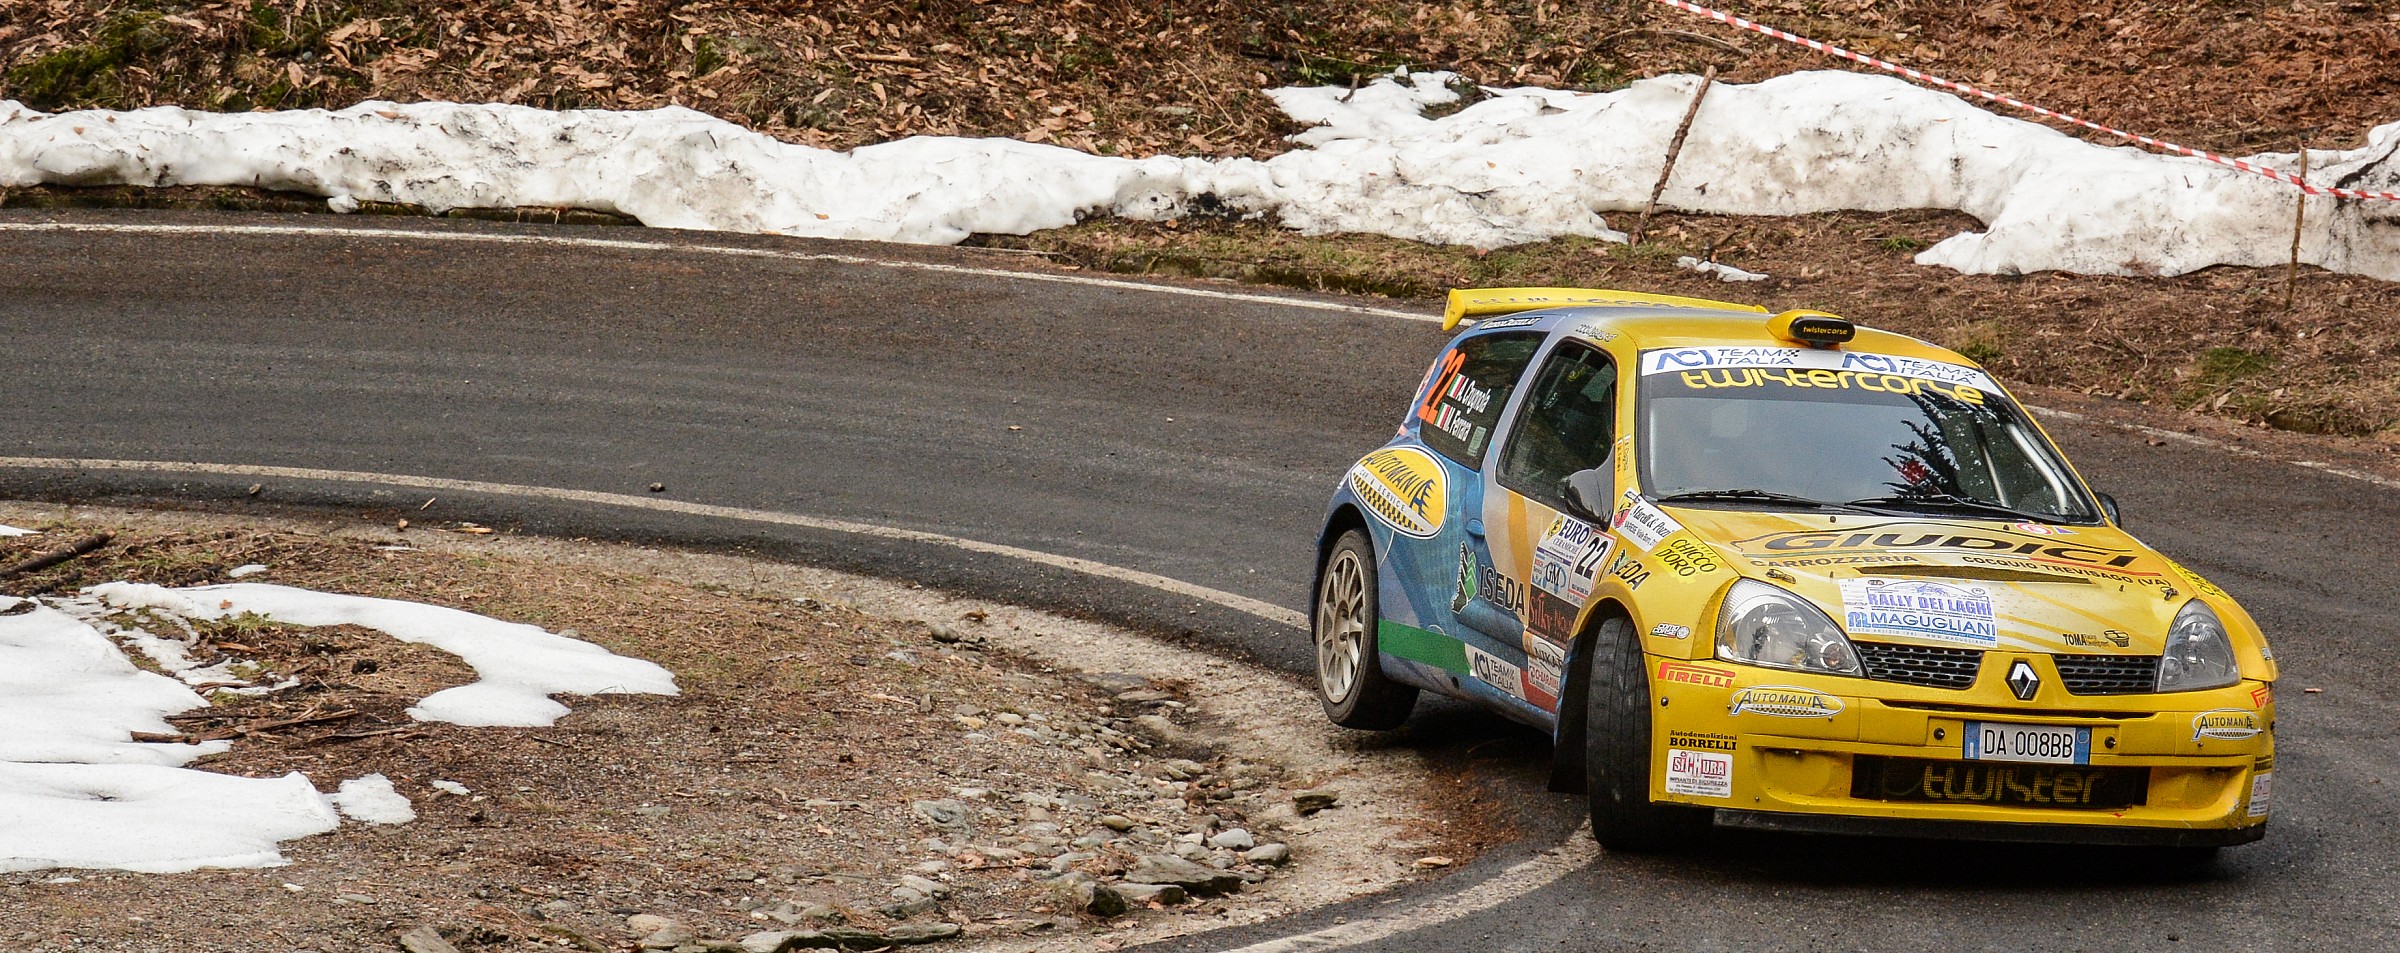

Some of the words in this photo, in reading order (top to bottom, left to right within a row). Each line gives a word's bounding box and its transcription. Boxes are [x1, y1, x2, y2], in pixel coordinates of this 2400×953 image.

[1803, 326, 1848, 335] twistercorse
[1656, 350, 1714, 370] ACI
[1718, 349, 1784, 358] TEAM
[1718, 357, 1794, 366] ITALIA
[1842, 353, 1897, 372] ACI
[1900, 359, 1960, 374] TEAM
[1418, 348, 1466, 425] 22
[1682, 368, 1985, 406] twistercorse
[1900, 367, 1974, 385] ITALIA
[1377, 485, 1406, 512] SERVICE
[1558, 518, 1590, 545] EURO
[1575, 536, 1609, 580] 22
[1670, 539, 1718, 572] CHICCO
[1751, 555, 1919, 568] CARROZZERIA
[1764, 533, 2138, 567] GIUDICI
[1962, 556, 2038, 569] COCQUIO
[2039, 564, 2134, 583] TREVISAGO
[2138, 578, 2172, 587] (VA)
[1479, 564, 1526, 616] ISEDA
[1868, 593, 1913, 608] RALLY
[1918, 596, 1945, 611] DEI
[1947, 599, 1993, 616] LAGHI
[1871, 612, 1996, 636] MAGUGLIANI
[2063, 633, 2087, 646] TOMA
[1658, 662, 1736, 688] PIRELLI
[1733, 690, 1826, 713] AUTOMANIA
[1669, 730, 1738, 741] Autodemolizioni
[2194, 715, 2254, 738] AUTOMANIA
[1669, 737, 1737, 751] BORRELLI
[1984, 729, 2007, 754] DA
[2015, 731, 2073, 758] 008BB
[1923, 765, 2102, 803] twister
